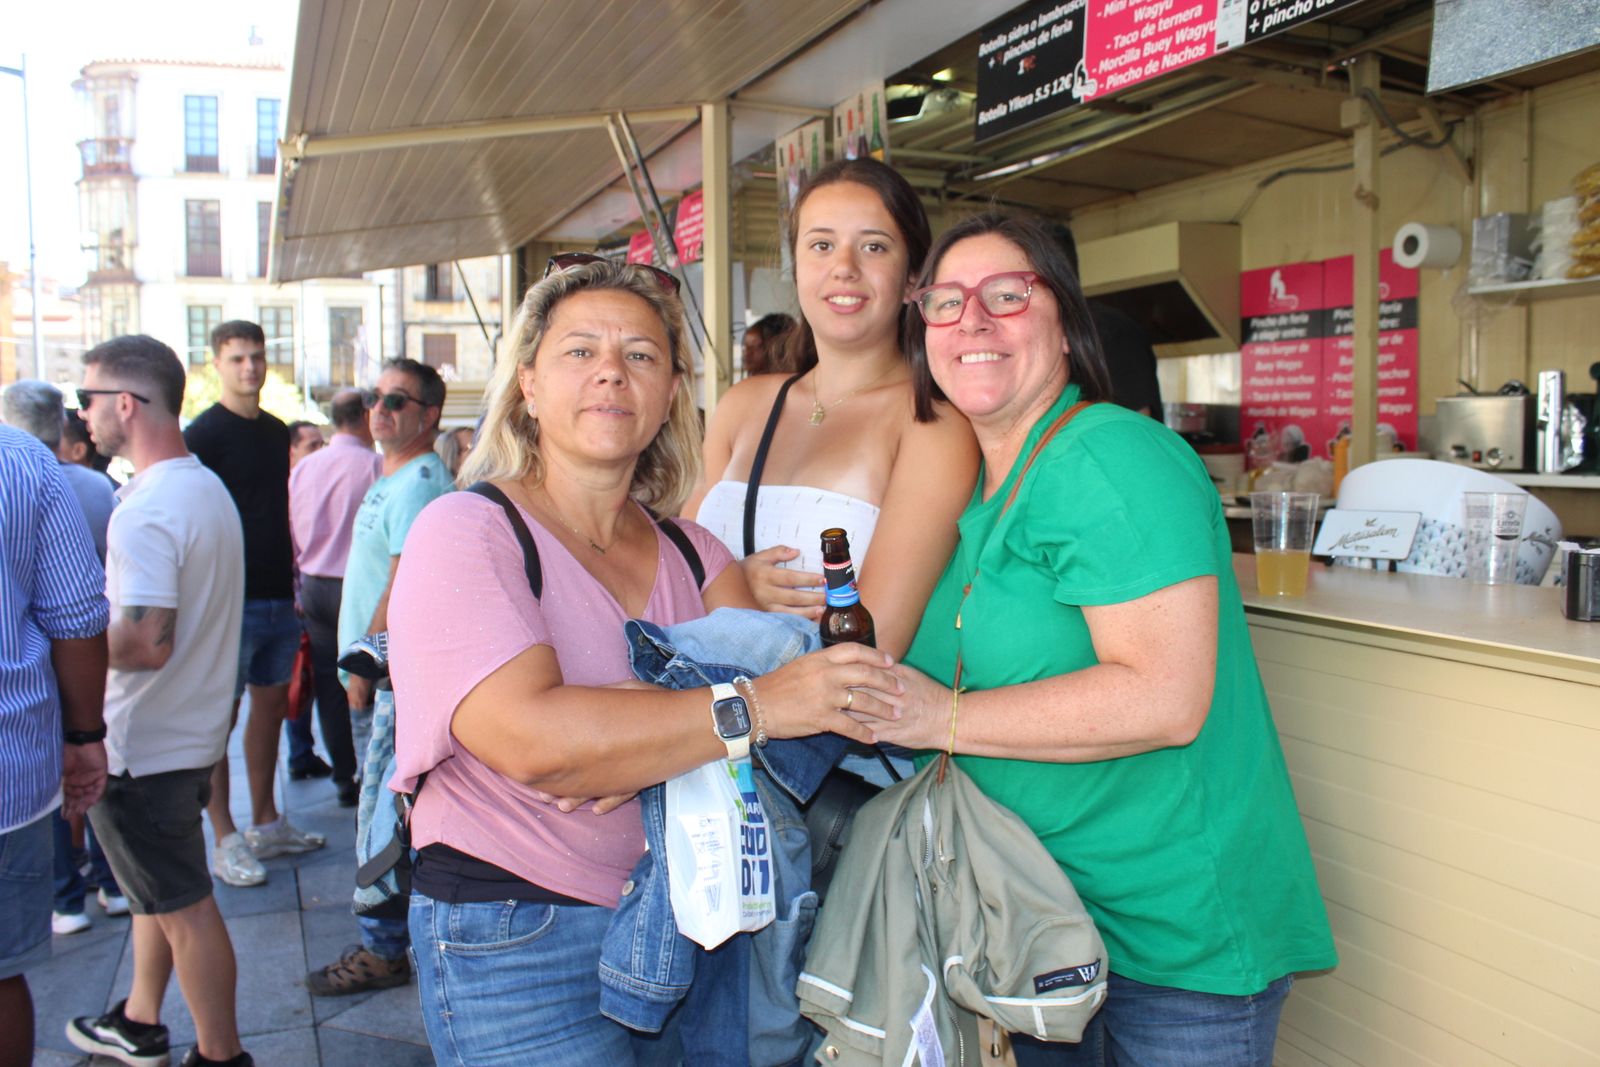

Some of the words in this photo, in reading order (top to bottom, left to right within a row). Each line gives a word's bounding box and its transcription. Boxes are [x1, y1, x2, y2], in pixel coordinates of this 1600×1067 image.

[1113, 30, 1140, 50] Taco
[1140, 22, 1157, 39] de
[1157, 4, 1204, 32] ternera
[1134, 0, 1174, 23] Wagyu
[1262, 0, 1314, 33] pincho
[979, 33, 1007, 58] Botella
[1007, 23, 1030, 43] sidra
[1030, 19, 1038, 32] o
[1003, 36, 1038, 65] pinchos
[1037, 30, 1051, 46] de
[1050, 18, 1074, 40] feria
[1098, 47, 1142, 75] Morcilla
[1142, 36, 1174, 57] Buey
[1174, 18, 1217, 45] Wagyu
[1105, 66, 1143, 90] Pincho
[1143, 59, 1160, 76] de
[1161, 42, 1208, 70] Nachos
[978, 103, 1008, 126] Botella
